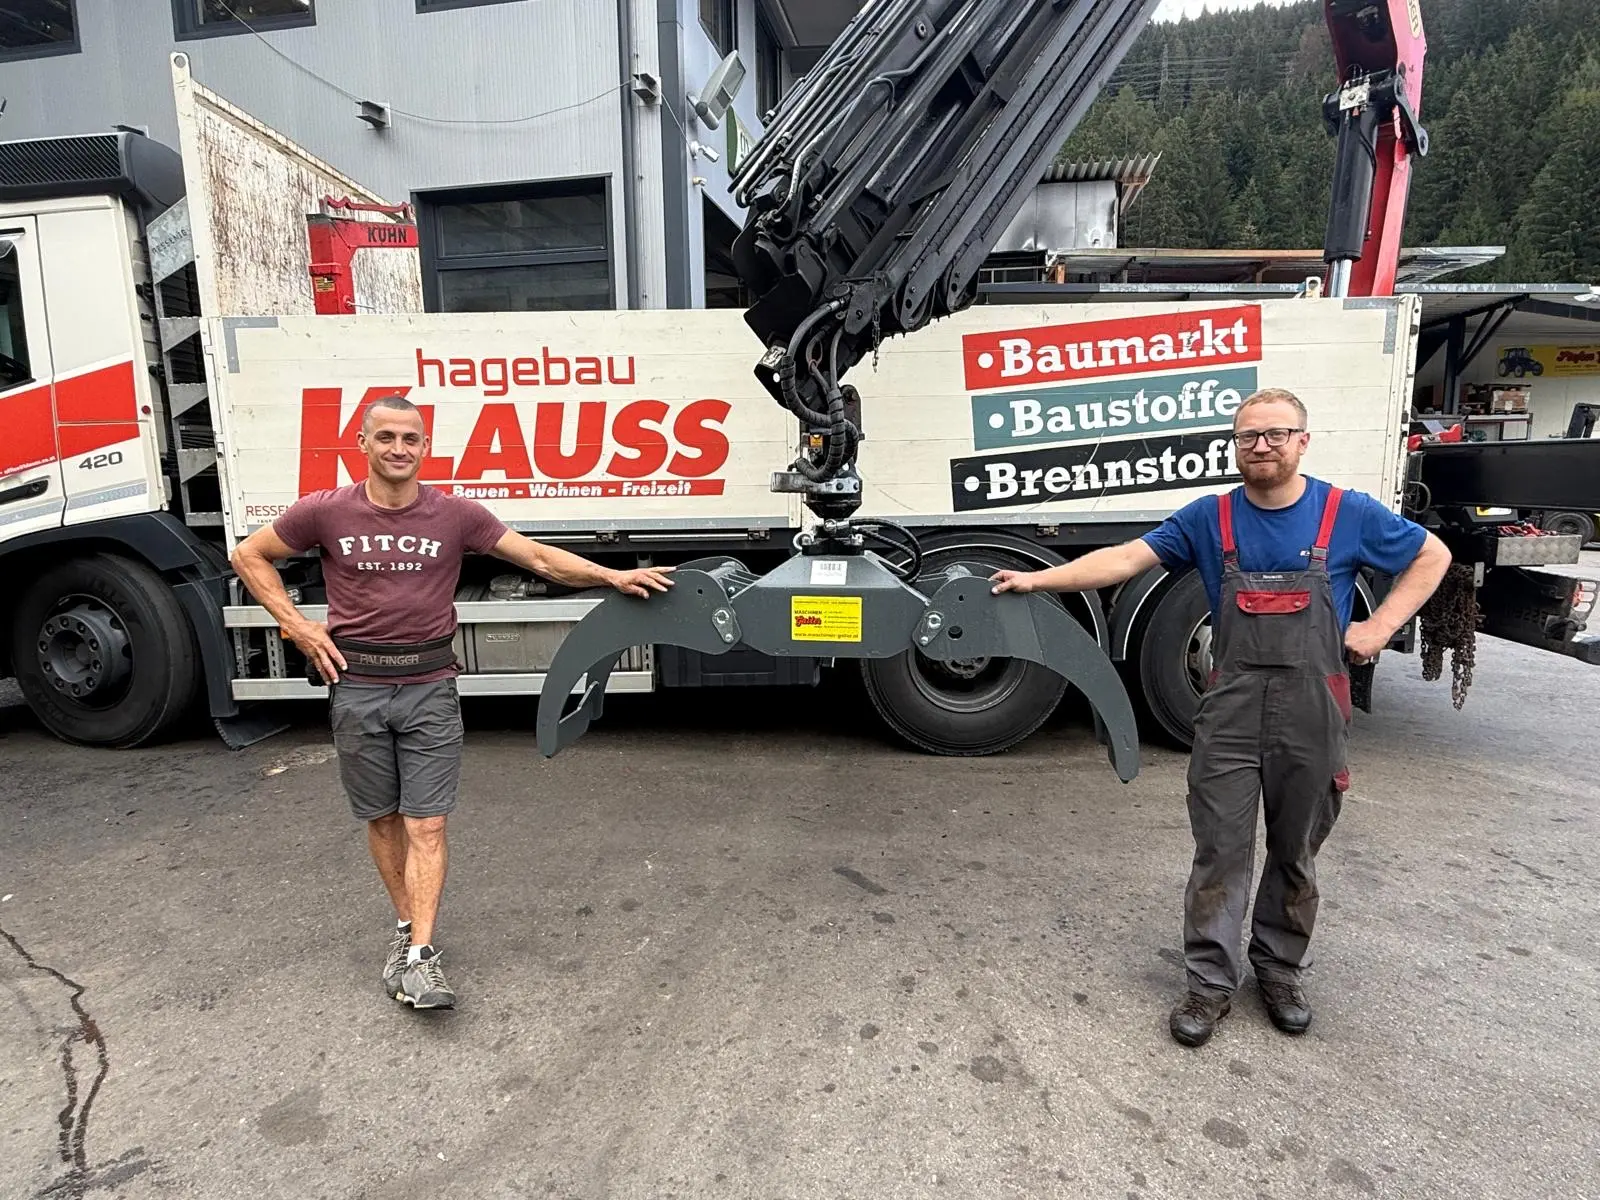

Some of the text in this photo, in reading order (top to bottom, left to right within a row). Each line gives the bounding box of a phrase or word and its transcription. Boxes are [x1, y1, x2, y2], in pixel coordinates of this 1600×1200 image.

[999, 317, 1249, 378] Baumarkt
[416, 346, 635, 397] hagebau
[1009, 379, 1242, 437] Baustoffe
[79, 451, 123, 470] 420
[452, 484, 509, 499] Bauen
[529, 482, 602, 497] Wohnen
[621, 480, 692, 496] Freizeit
[245, 505, 289, 517] RESSE
[338, 535, 442, 558] FITCH
[357, 562, 423, 571] EST. 1892
[360, 653, 420, 667] PALFINGER
